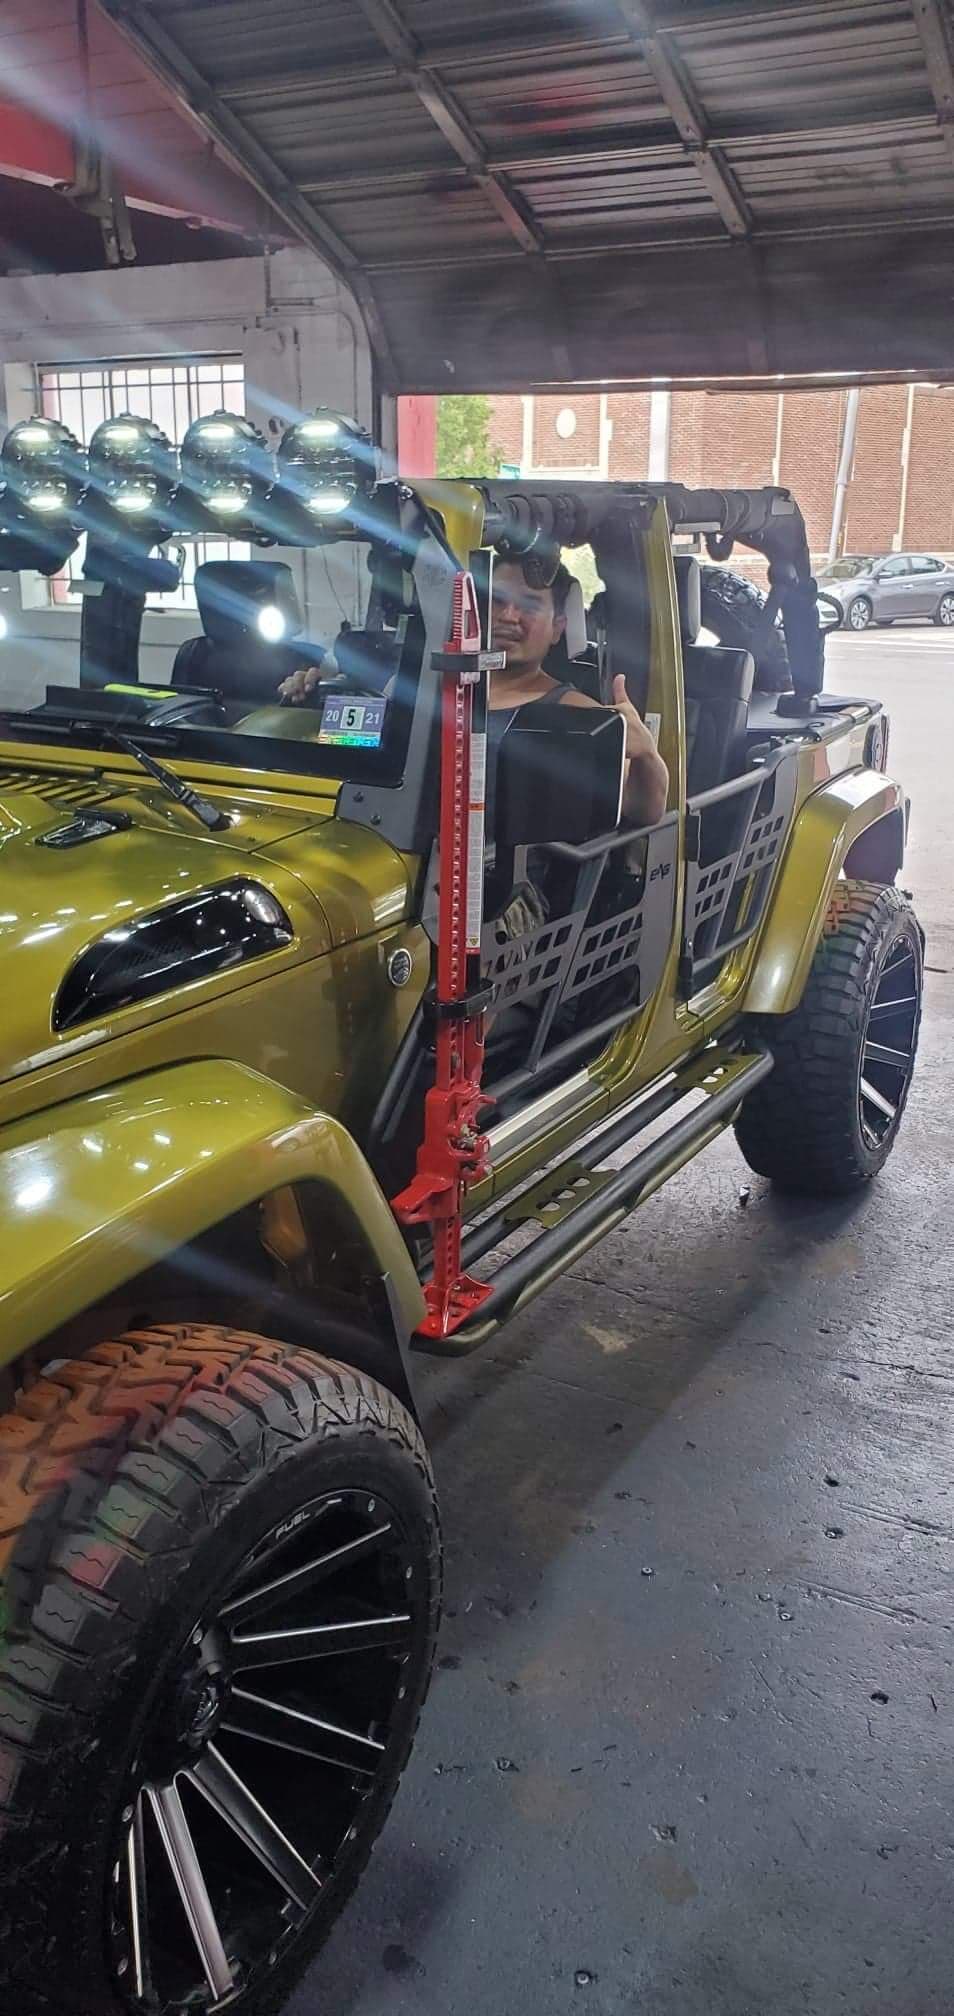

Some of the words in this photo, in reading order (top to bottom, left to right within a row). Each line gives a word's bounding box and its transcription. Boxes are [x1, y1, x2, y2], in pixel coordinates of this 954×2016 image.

[325, 710, 340, 722] 20
[346, 708, 357, 727] 5
[365, 712, 380, 725] 21
[275, 1511, 311, 1540] FUEL
